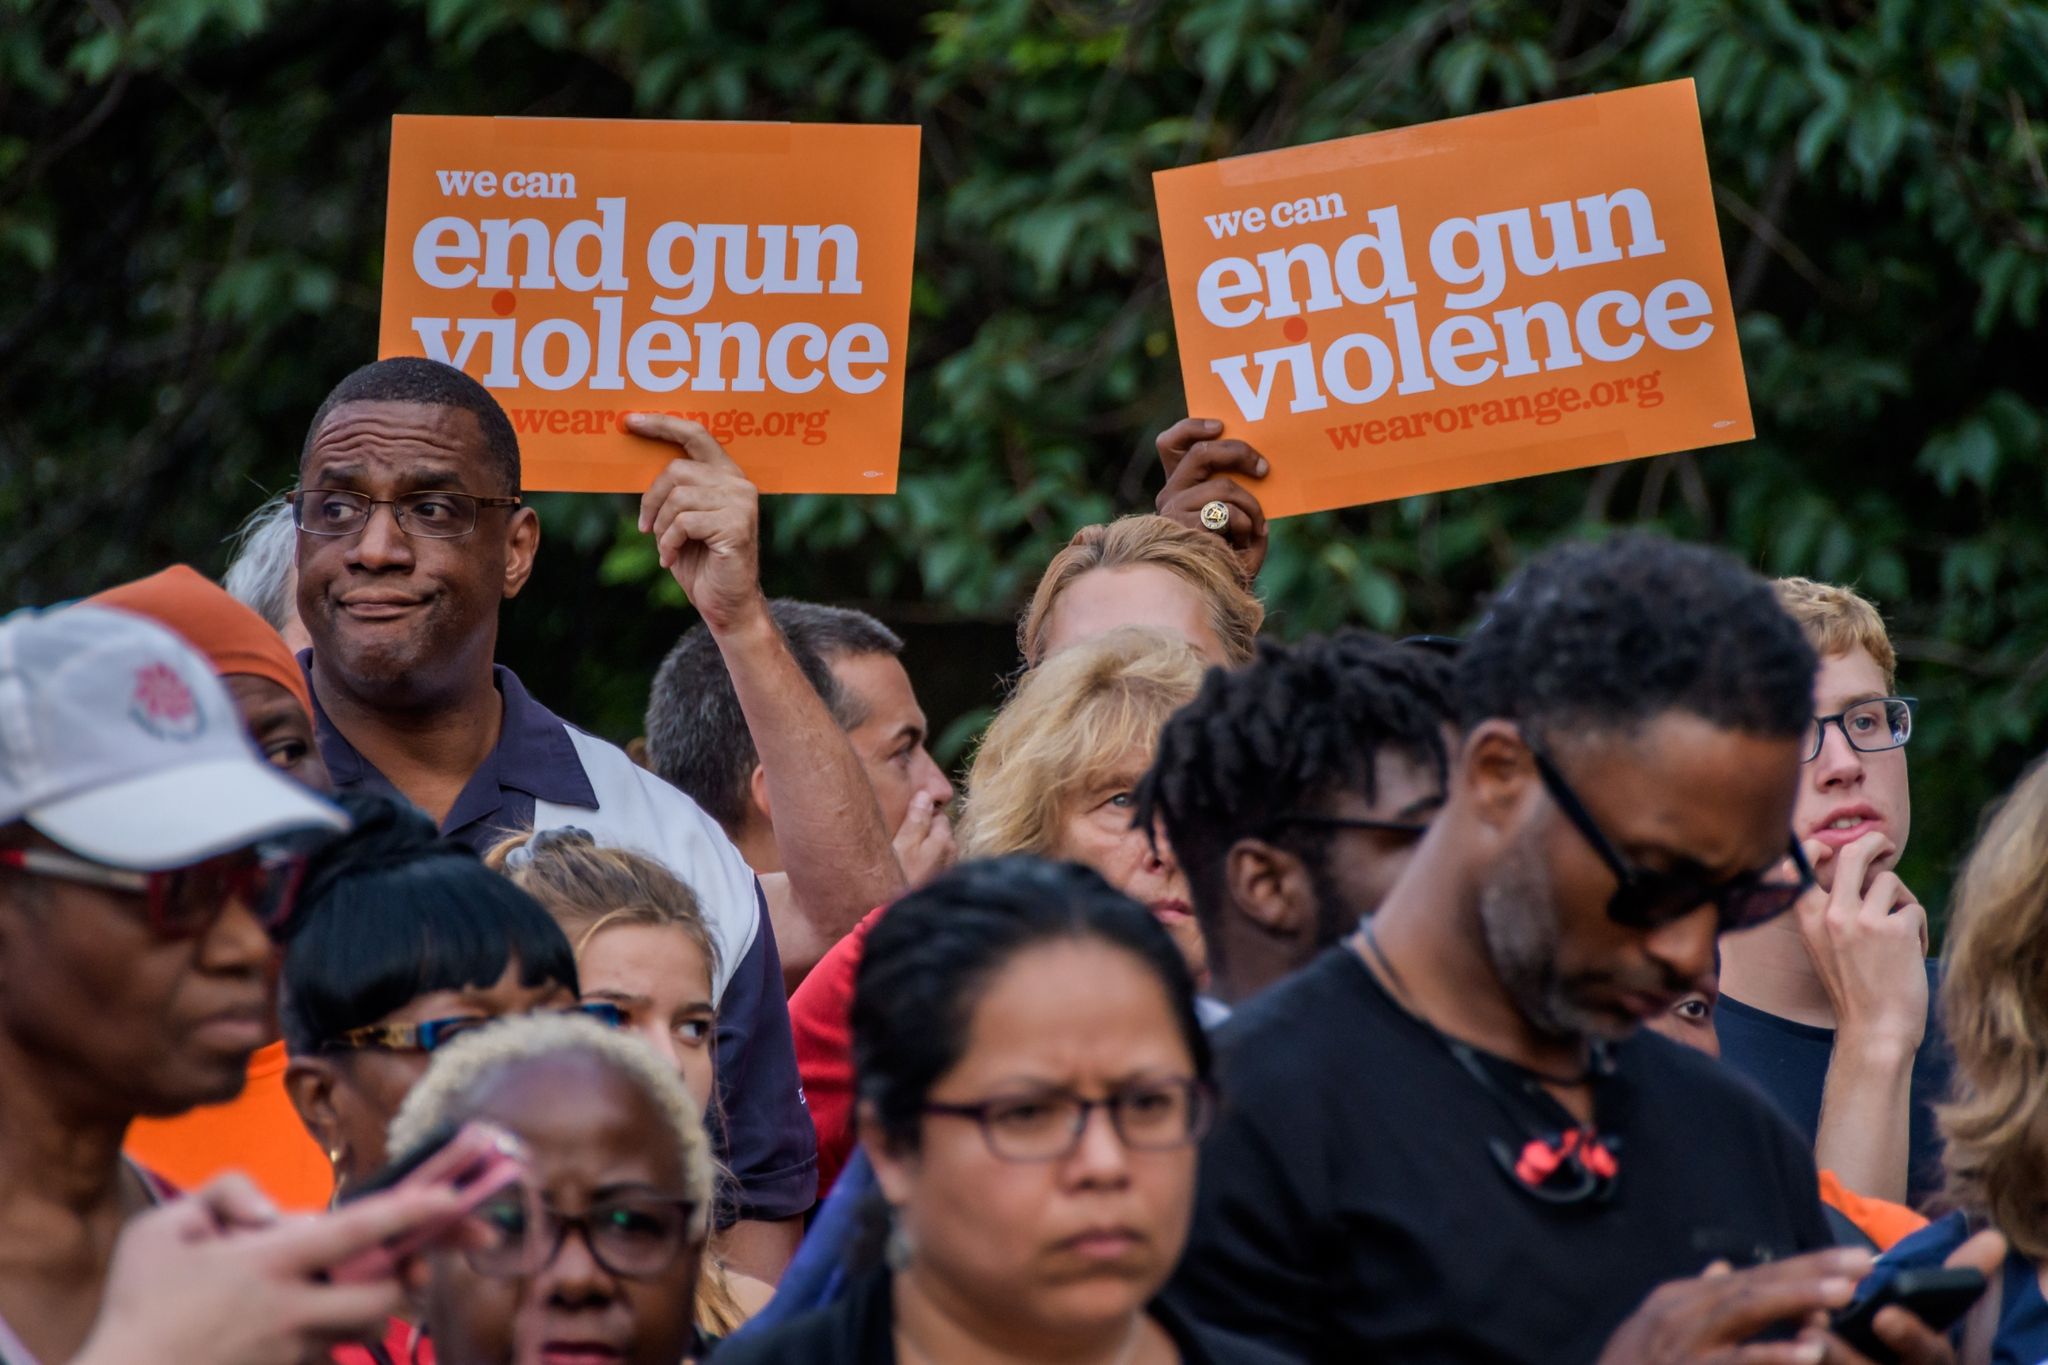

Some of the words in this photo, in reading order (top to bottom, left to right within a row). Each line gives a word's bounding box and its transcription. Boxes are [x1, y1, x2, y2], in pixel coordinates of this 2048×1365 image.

[436, 170, 497, 197] we
[502, 171, 577, 198] can
[1204, 206, 1266, 240] we
[1271, 193, 1348, 228] can
[412, 197, 628, 292] end
[646, 221, 862, 315] gun
[1197, 205, 1417, 329] end
[1429, 187, 1665, 310] gun
[411, 289, 889, 394] violence
[1210, 279, 1714, 423] violence
[1325, 370, 1664, 451] wearorange.org
